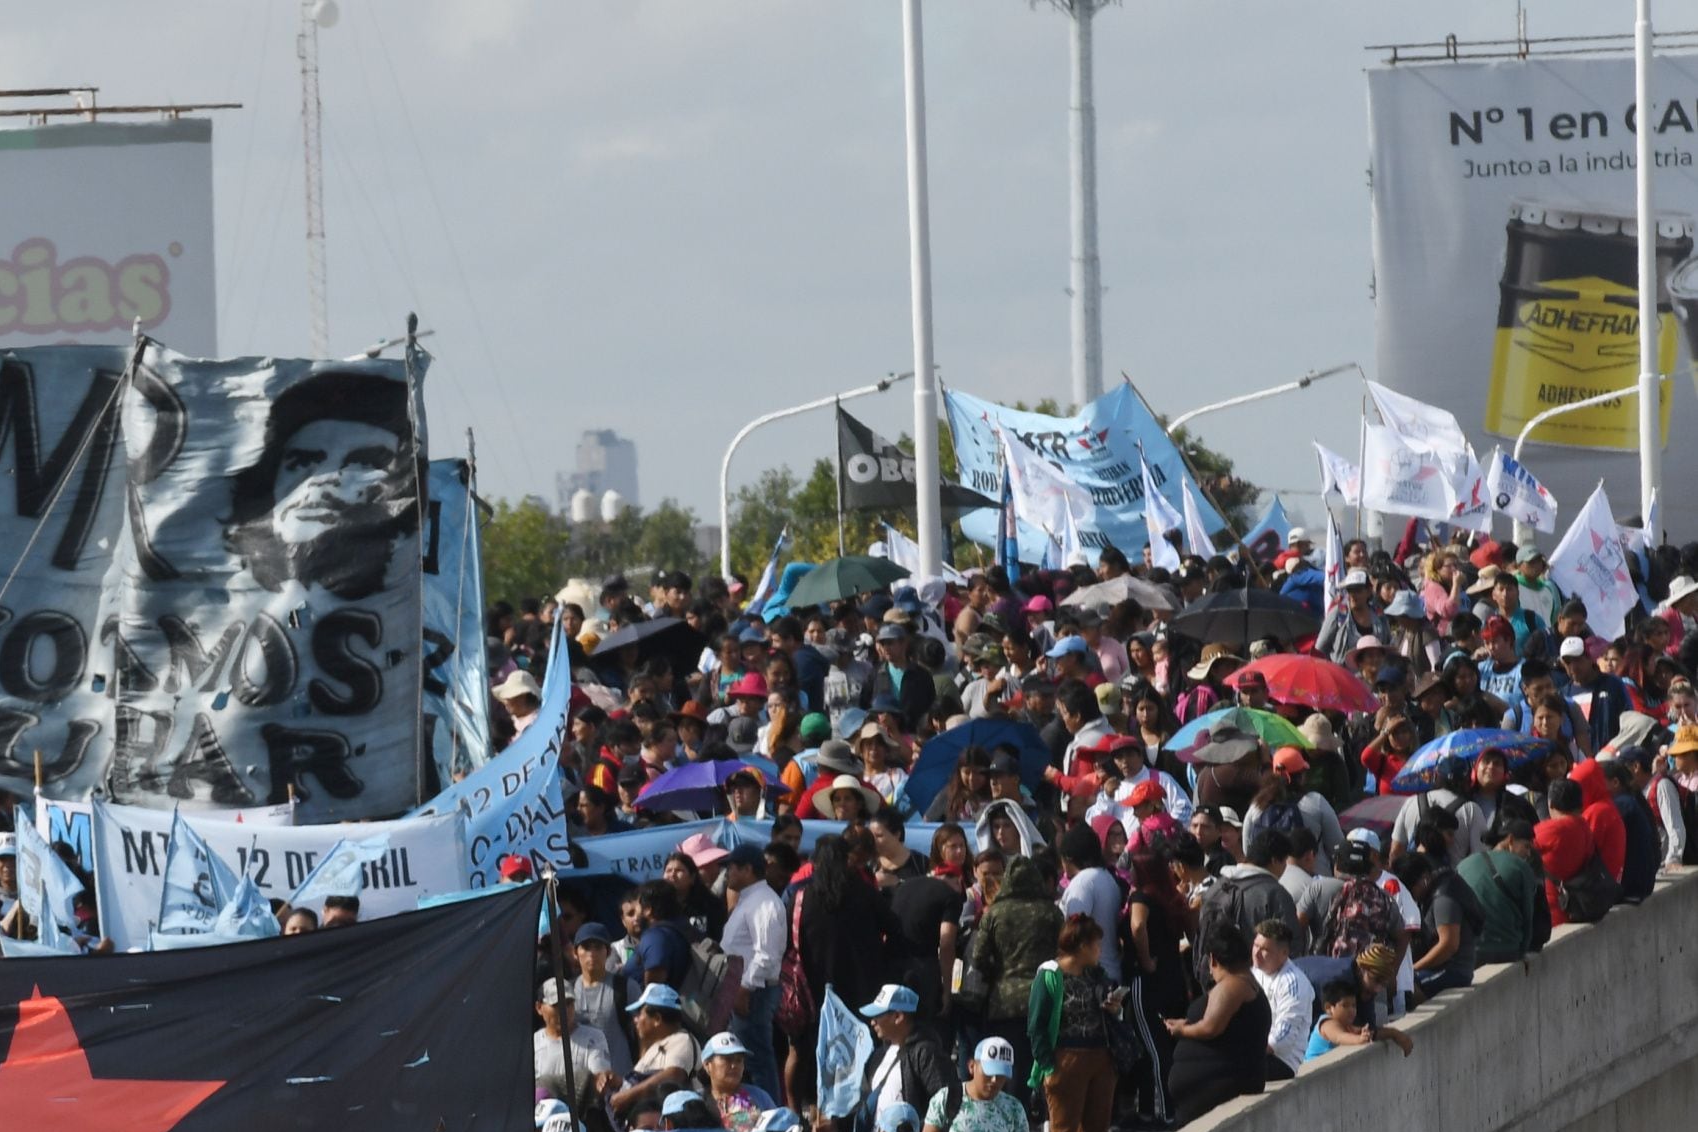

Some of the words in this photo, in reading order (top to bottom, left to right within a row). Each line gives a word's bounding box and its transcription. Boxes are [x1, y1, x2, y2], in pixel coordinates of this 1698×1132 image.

[1517, 106, 1535, 142] 1
[1548, 110, 1609, 141] en
[1624, 98, 1698, 137] CA
[1463, 157, 1533, 180] Junto
[1538, 158, 1551, 175] a
[1558, 153, 1579, 174] la
[1586, 149, 1693, 172] indutria
[847, 453, 916, 484] OBR
[236, 846, 273, 889] 12
